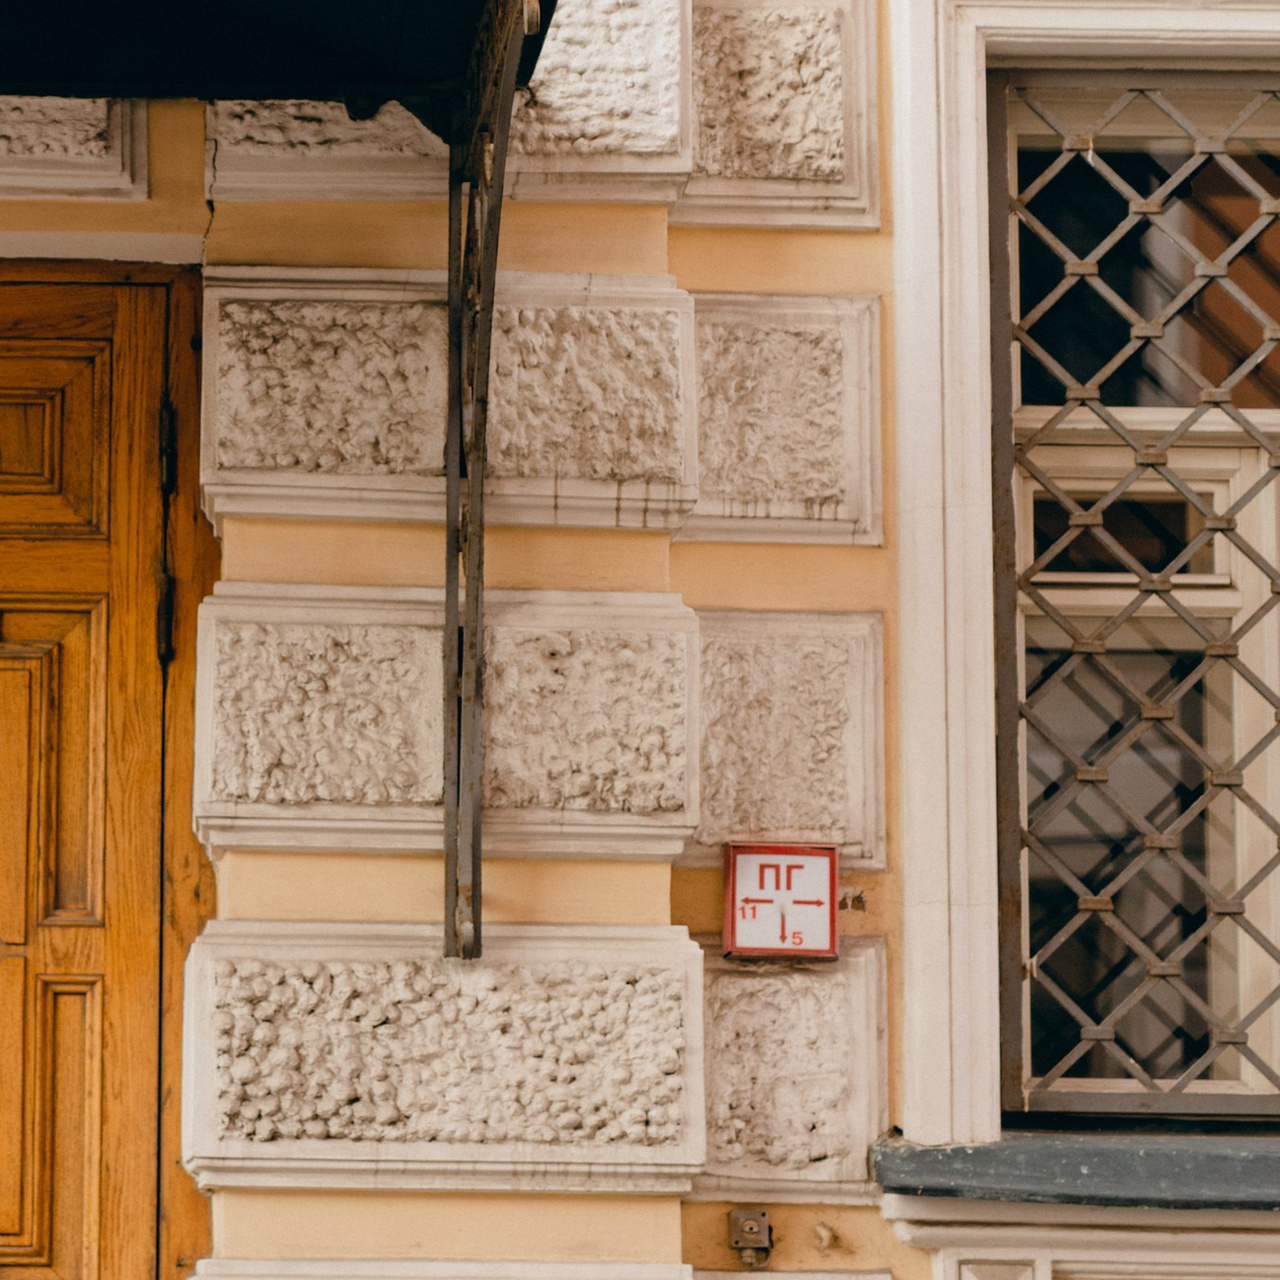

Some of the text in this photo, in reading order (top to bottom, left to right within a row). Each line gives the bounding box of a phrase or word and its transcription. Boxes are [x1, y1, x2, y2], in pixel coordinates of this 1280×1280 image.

[759, 864, 804, 891] ПГ
[739, 906, 757, 920] 11
[791, 932, 804, 946] 5
